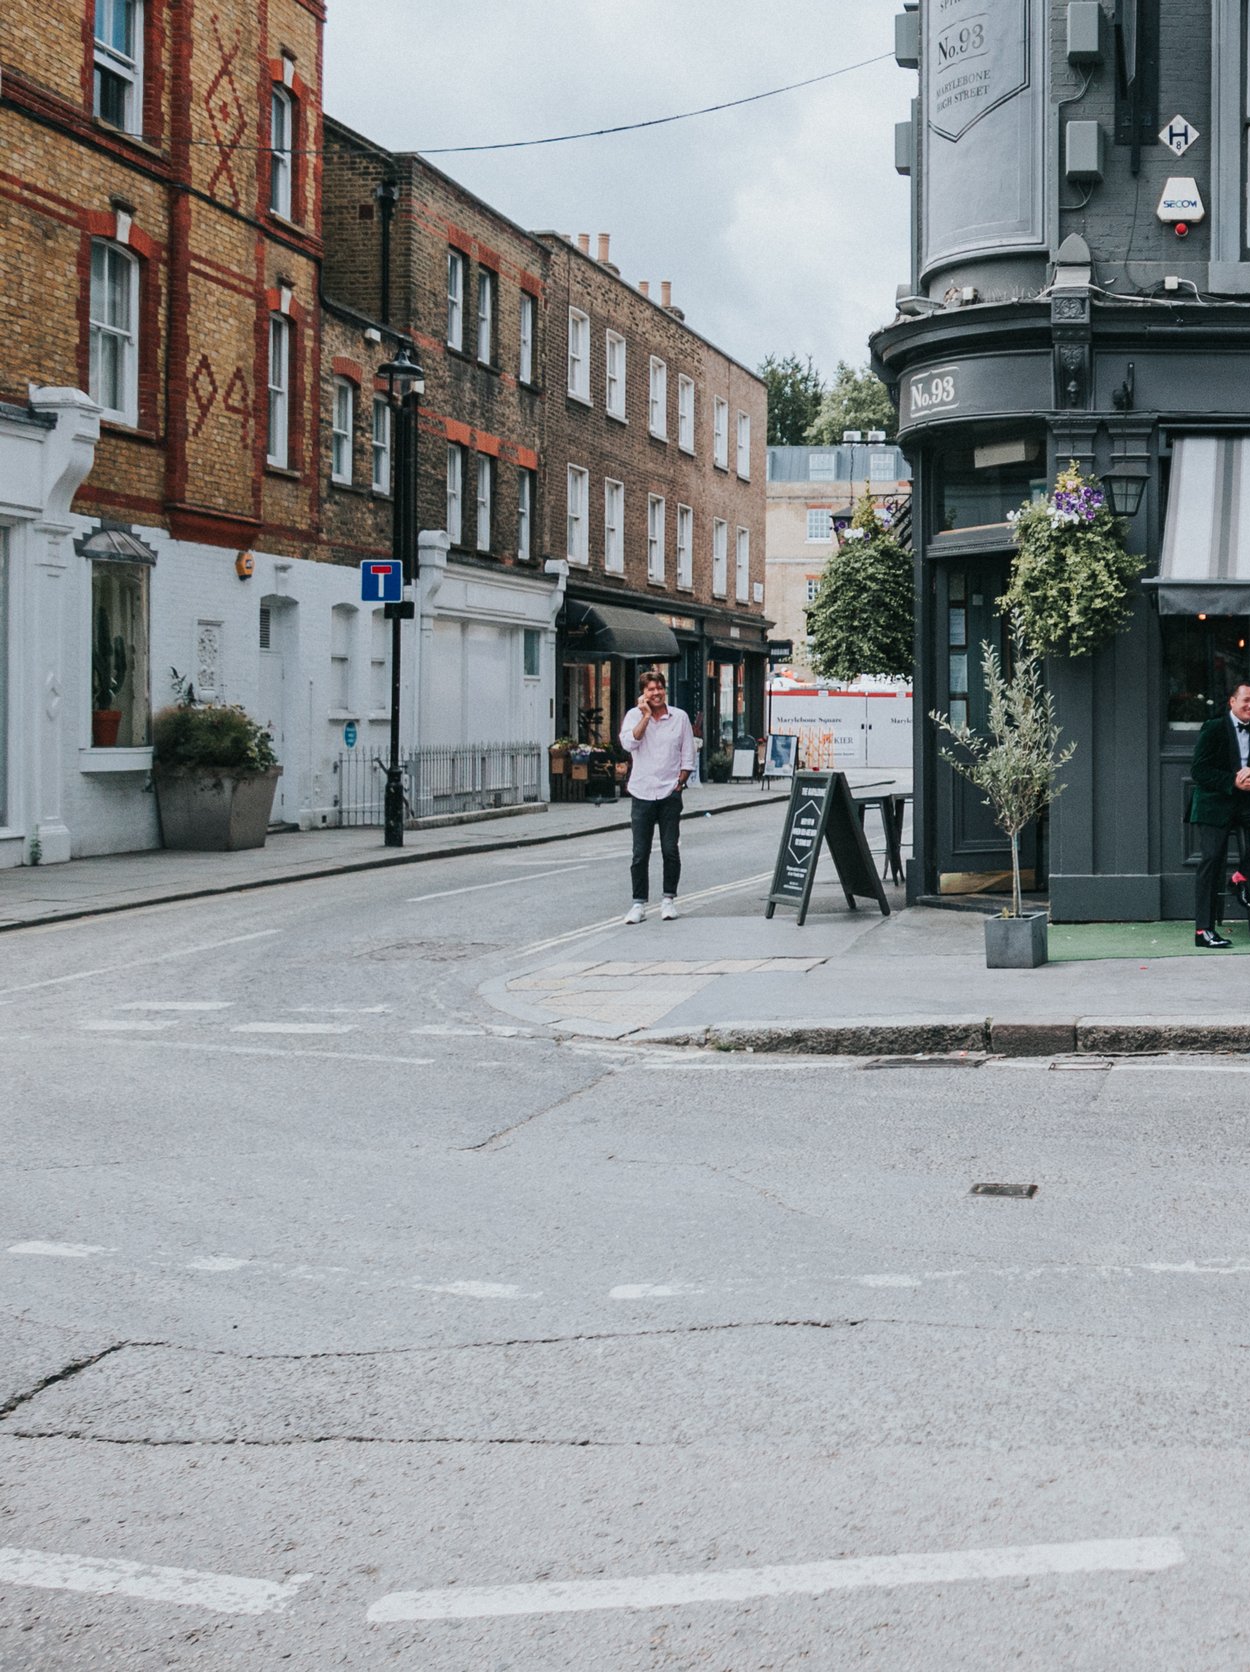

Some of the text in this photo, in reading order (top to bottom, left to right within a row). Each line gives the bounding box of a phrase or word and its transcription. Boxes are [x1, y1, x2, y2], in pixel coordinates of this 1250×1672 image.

[936, 69, 991, 97] MARYLEBONE
[954, 85, 990, 104] STREET
[1169, 124, 1188, 146] H
[1176, 140, 1182, 150] 8
[1163, 200, 1198, 209] SECOM
[911, 376, 955, 411] No.93
[834, 736, 854, 744] KIER
